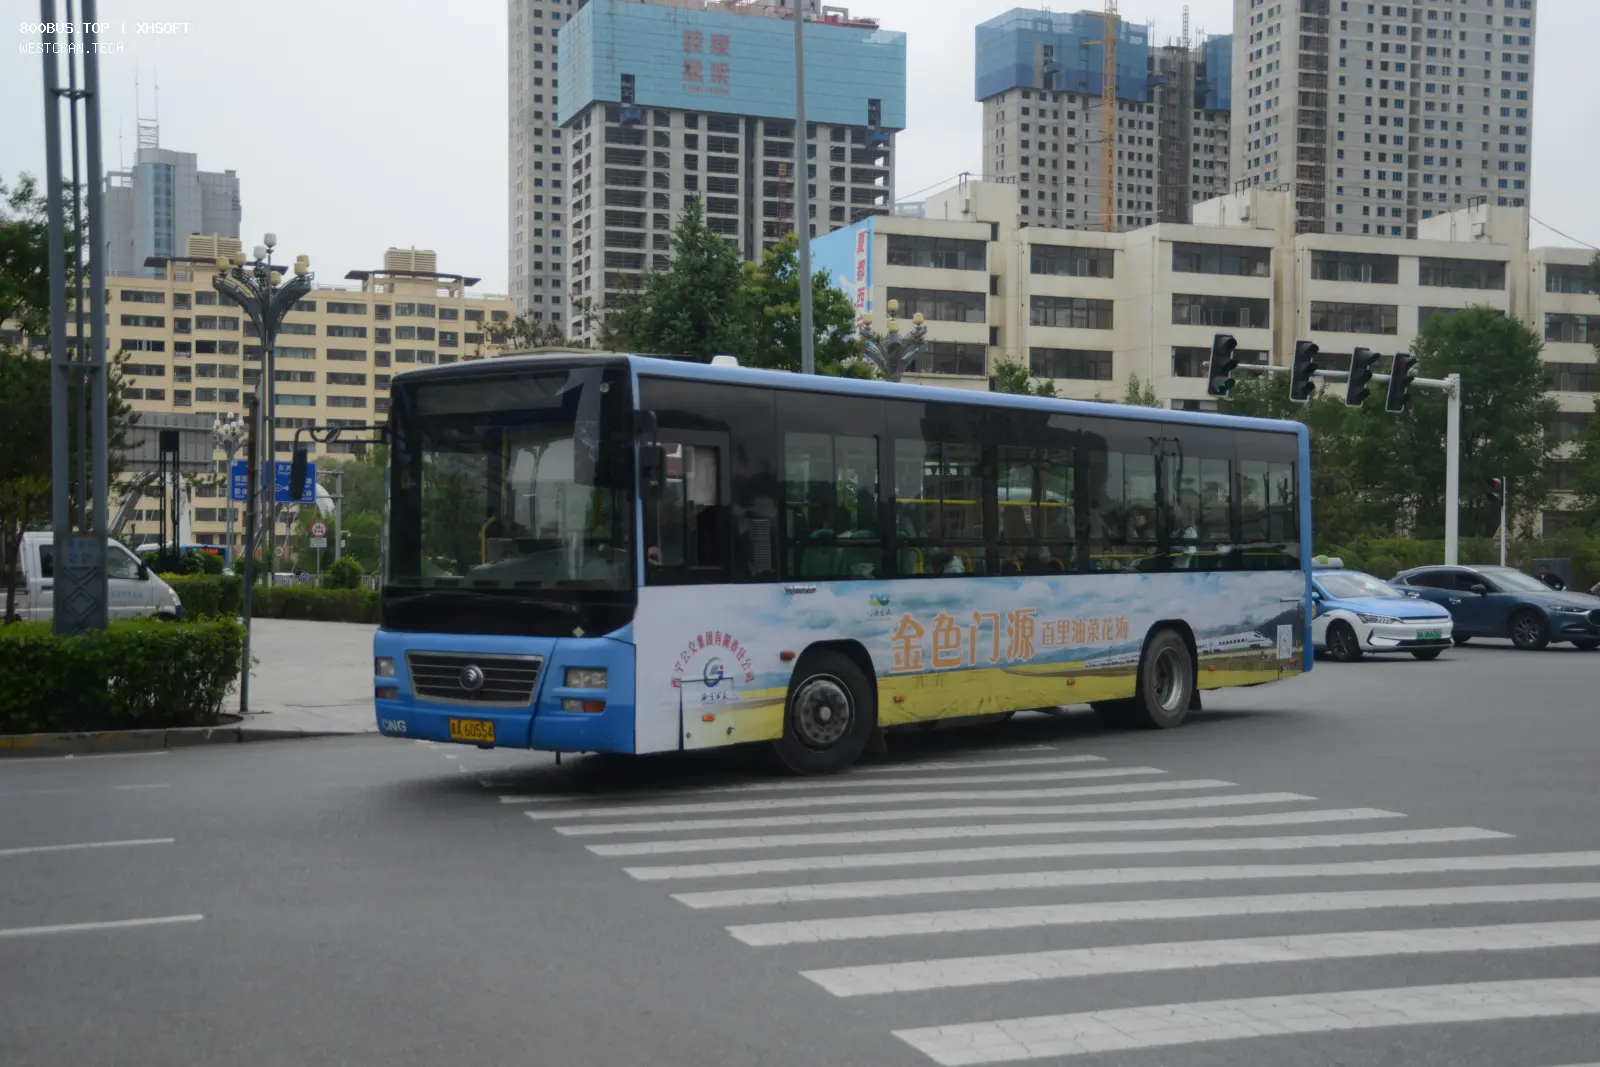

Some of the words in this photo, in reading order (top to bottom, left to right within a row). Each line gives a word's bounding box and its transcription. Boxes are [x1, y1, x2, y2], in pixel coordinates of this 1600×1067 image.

[890, 607, 1036, 672] 金色门源
[1041, 615, 1129, 647] 百里油菜花海
[381, 719, 408, 732] CNG
